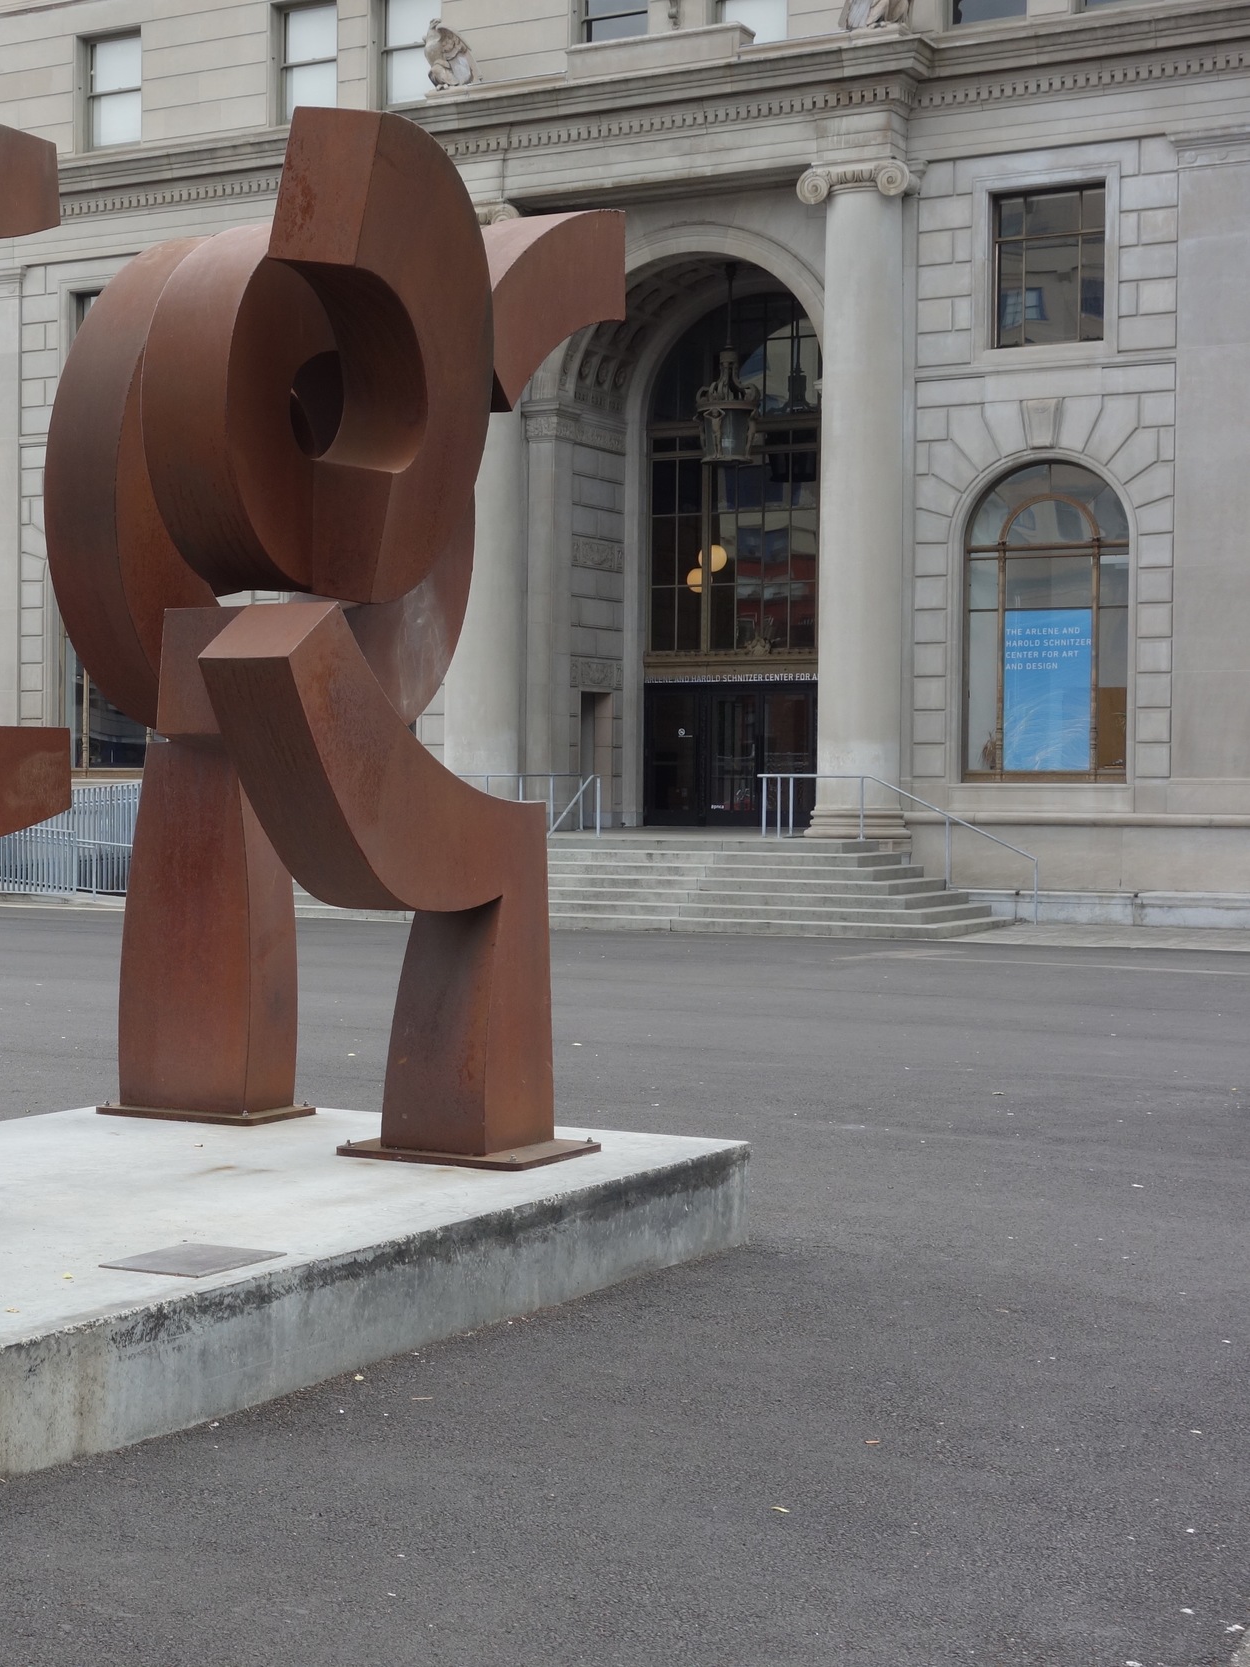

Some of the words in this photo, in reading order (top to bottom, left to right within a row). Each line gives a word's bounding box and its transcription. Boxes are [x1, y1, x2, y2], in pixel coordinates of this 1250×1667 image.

[1006, 628, 1023, 636] THE
[1025, 627, 1059, 635] ARLENE
[1062, 626, 1081, 634] AND
[1005, 639, 1041, 647] HAROLD
[1043, 638, 1092, 647] SCHNITZER
[1005, 651, 1039, 659] CENTER
[1042, 650, 1059, 658] FOR
[1026, 662, 1058, 670] DESIGN
[691, 674, 720, 682] HAROLD
[722, 673, 763, 682] SCHNITZER
[764, 673, 793, 681] CENTER
[795, 673, 810, 681] FOR
